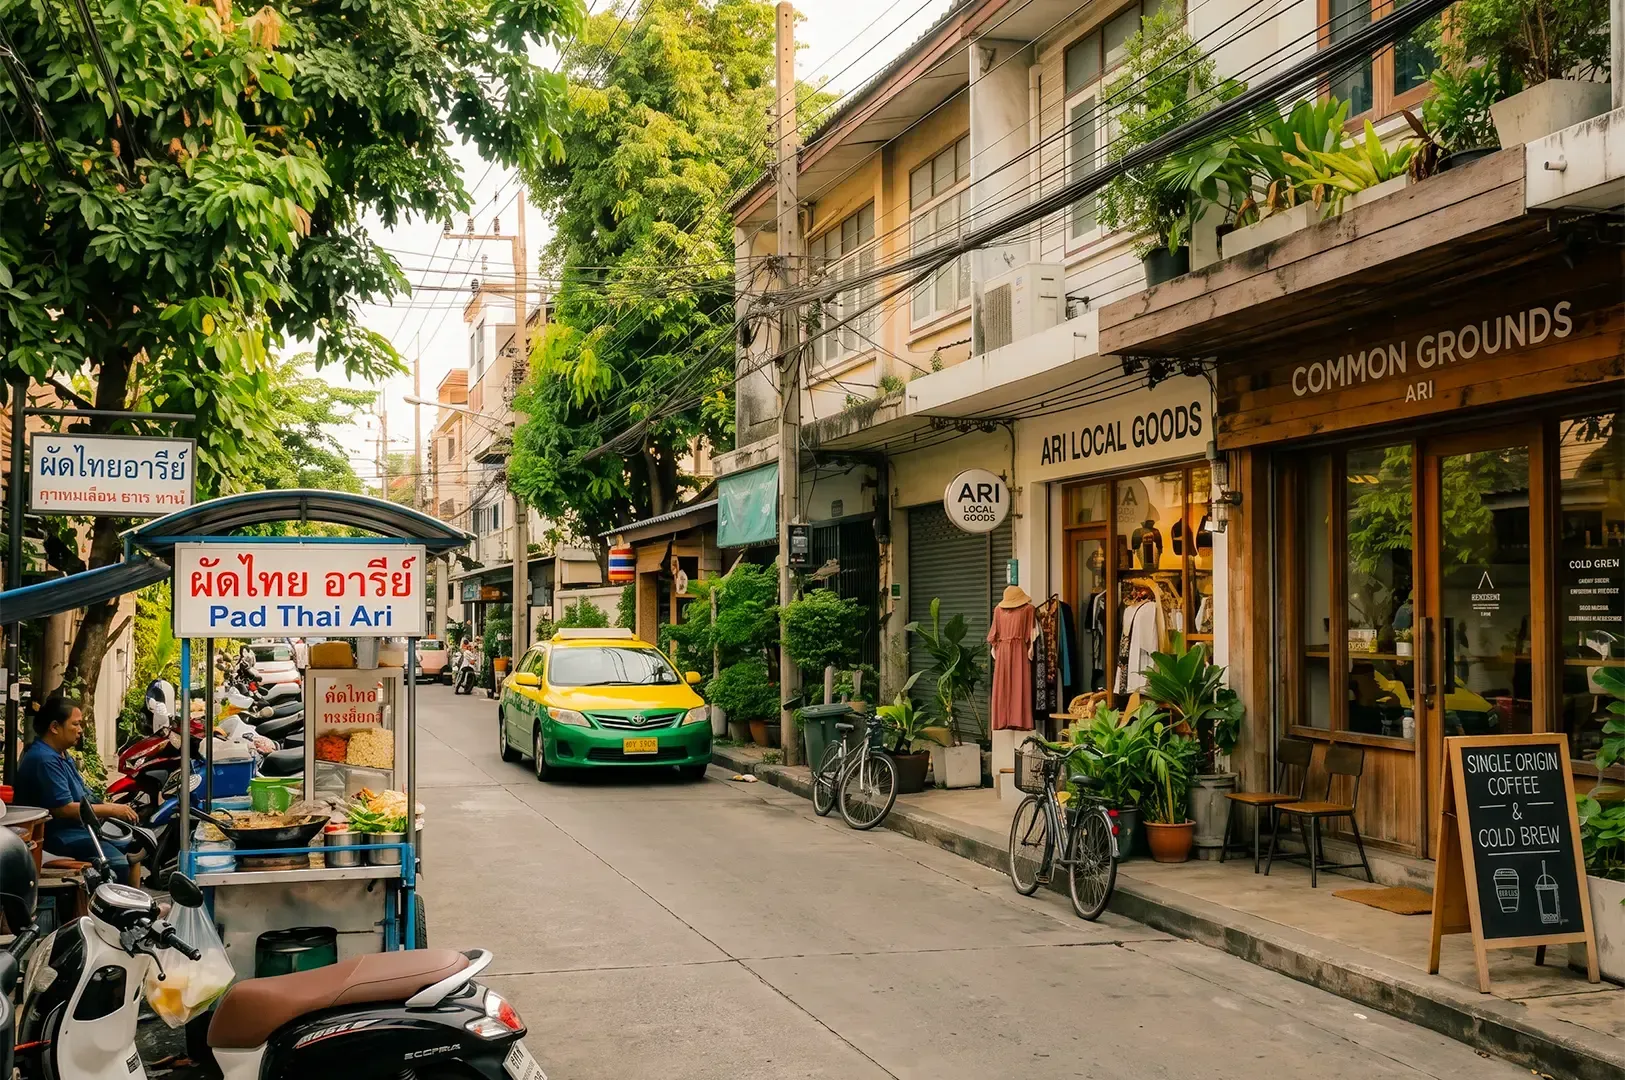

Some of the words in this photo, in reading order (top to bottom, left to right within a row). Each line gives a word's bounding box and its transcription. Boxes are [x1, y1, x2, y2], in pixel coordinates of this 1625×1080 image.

[1291, 341, 1407, 397] COMMON
[1416, 300, 1573, 369] GROUNDS
[1405, 380, 1433, 403] ARI
[1041, 433, 1067, 466] ARI
[1072, 421, 1127, 460] LOCAL
[1132, 401, 1202, 448] GOODS
[40, 444, 188, 480] ผัดไทยอารีย์
[958, 483, 999, 503] ARI
[963, 505, 995, 513] LOCAL
[963, 514, 996, 522] GOODS
[190, 553, 308, 597] ผัดไทย
[325, 556, 416, 597] อารีย์
[1569, 560, 1592, 569] COLD
[210, 605, 266, 627] Pad
[277, 605, 340, 627] Thai
[350, 605, 392, 627] Ari
[1467, 754, 1512, 774] SINGLE
[1515, 752, 1558, 771] ORIGIN
[1488, 776, 1540, 796] COFFEE
[1512, 802, 1523, 820] &
[1479, 827, 1515, 848] COLD
[1520, 825, 1560, 846] BREW
